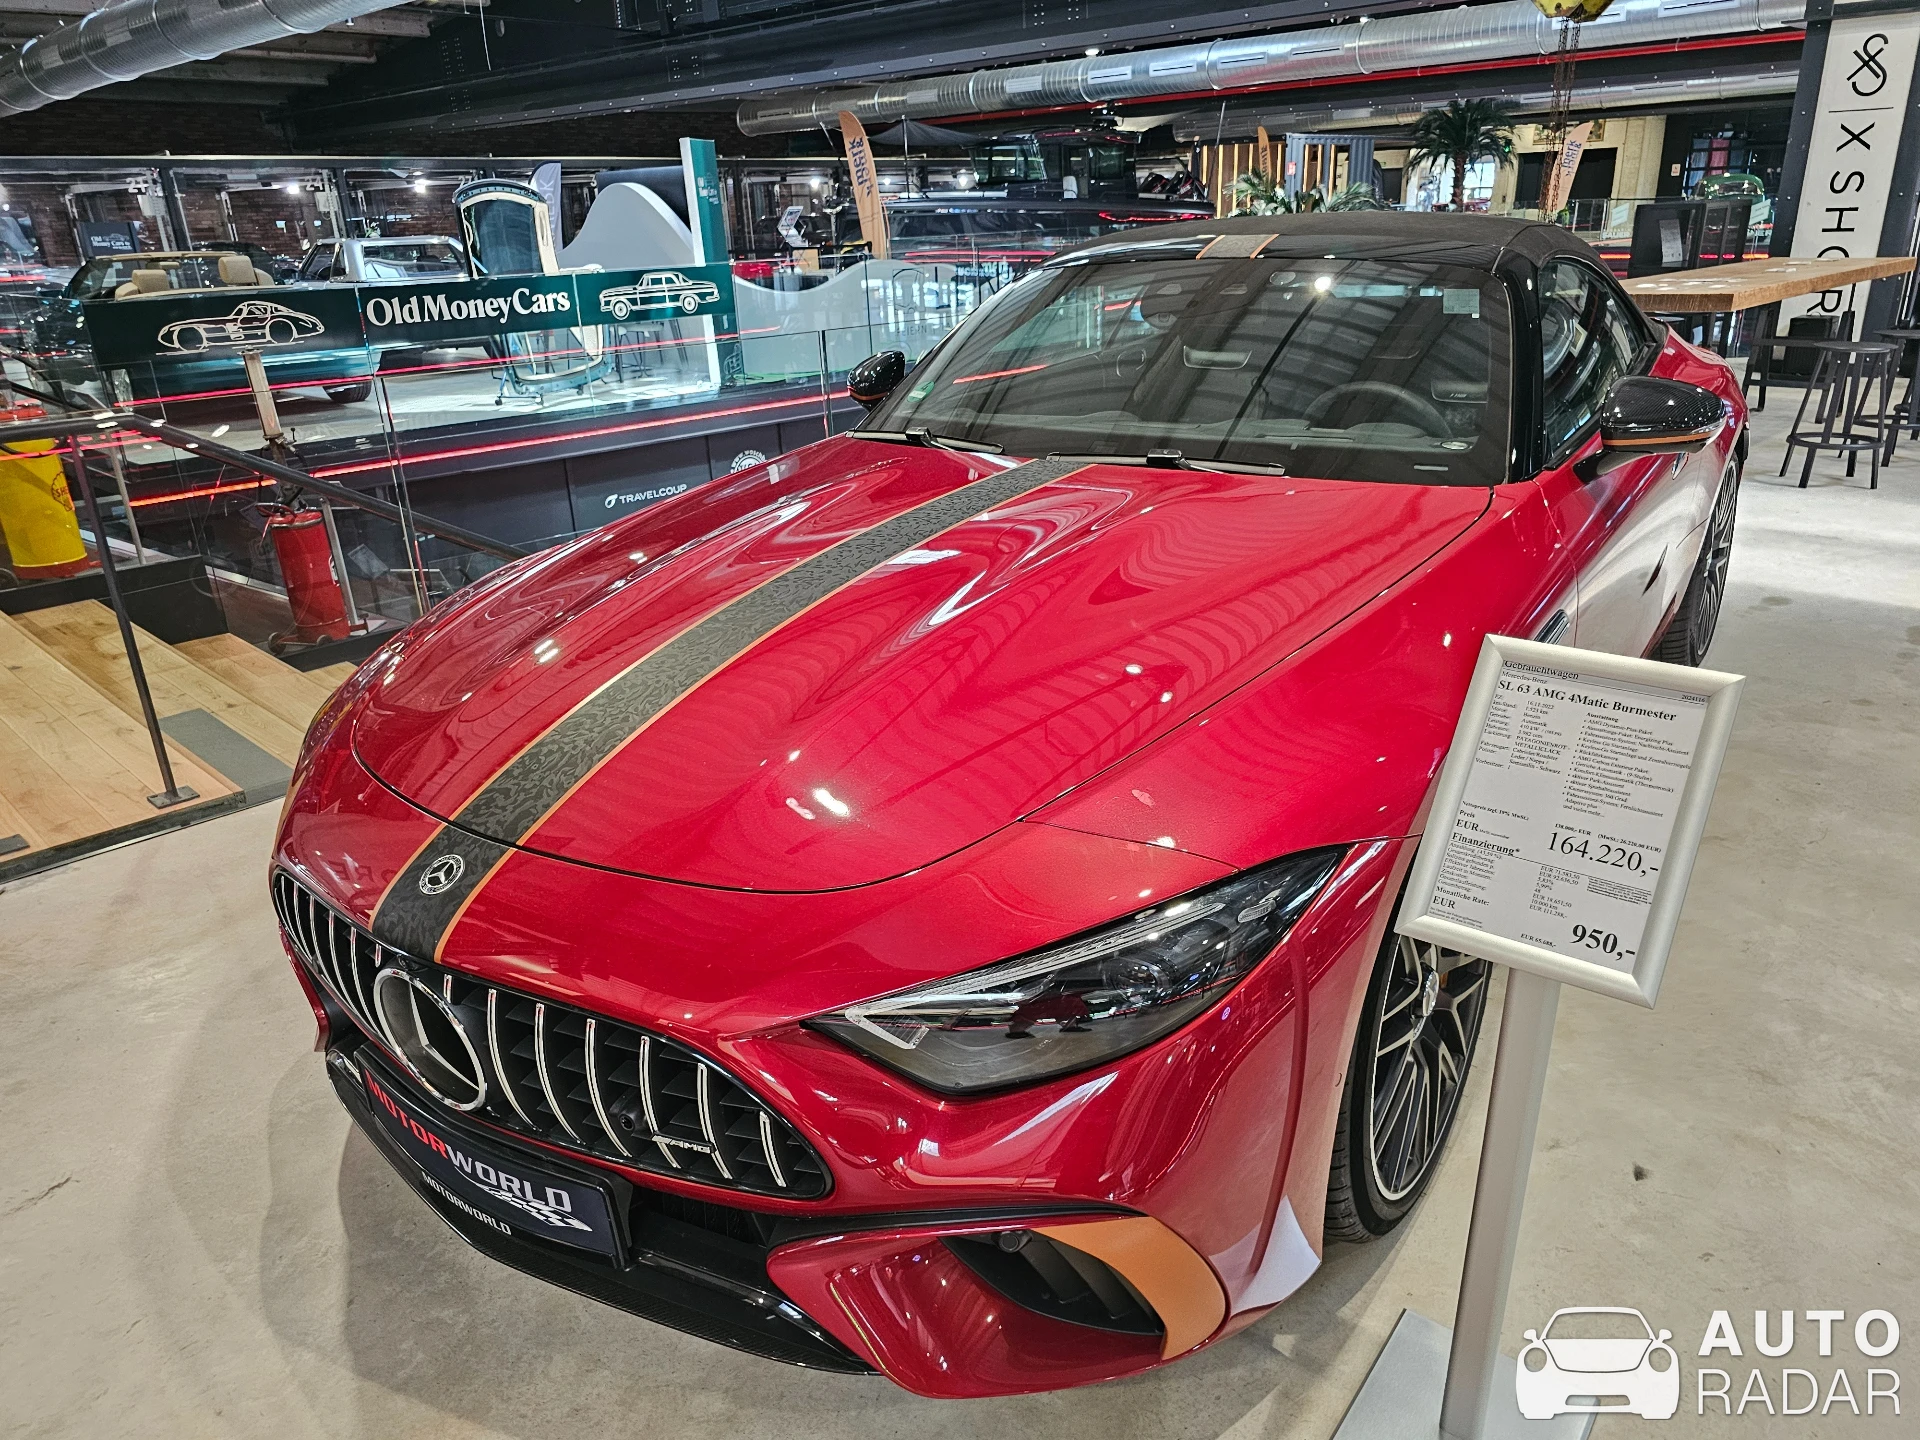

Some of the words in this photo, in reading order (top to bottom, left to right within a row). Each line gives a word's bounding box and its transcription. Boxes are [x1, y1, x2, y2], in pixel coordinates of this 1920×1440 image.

[619, 483, 688, 504] TRAVELCOUP
[1501, 670, 1548, 684] Mercedes-Benz
[1503, 660, 1579, 681] Gebrauchtwagen
[1497, 679, 1515, 690] SL
[1516, 683, 1530, 693] 63
[1532, 686, 1565, 700] AMG
[1567, 692, 1609, 709] 4Matic
[1611, 701, 1677, 722] Burmester
[1459, 809, 1475, 818] Preis
[1455, 818, 1479, 831] EUR
[1578, 828, 1591, 836] EUR
[1545, 830, 1661, 880] 164.220,-
[1435, 885, 1471, 900] Monatliche
[1432, 895, 1456, 909] EUR
[1568, 923, 1638, 965] 950,-
[421, 1170, 512, 1236] MOTORWORLD
